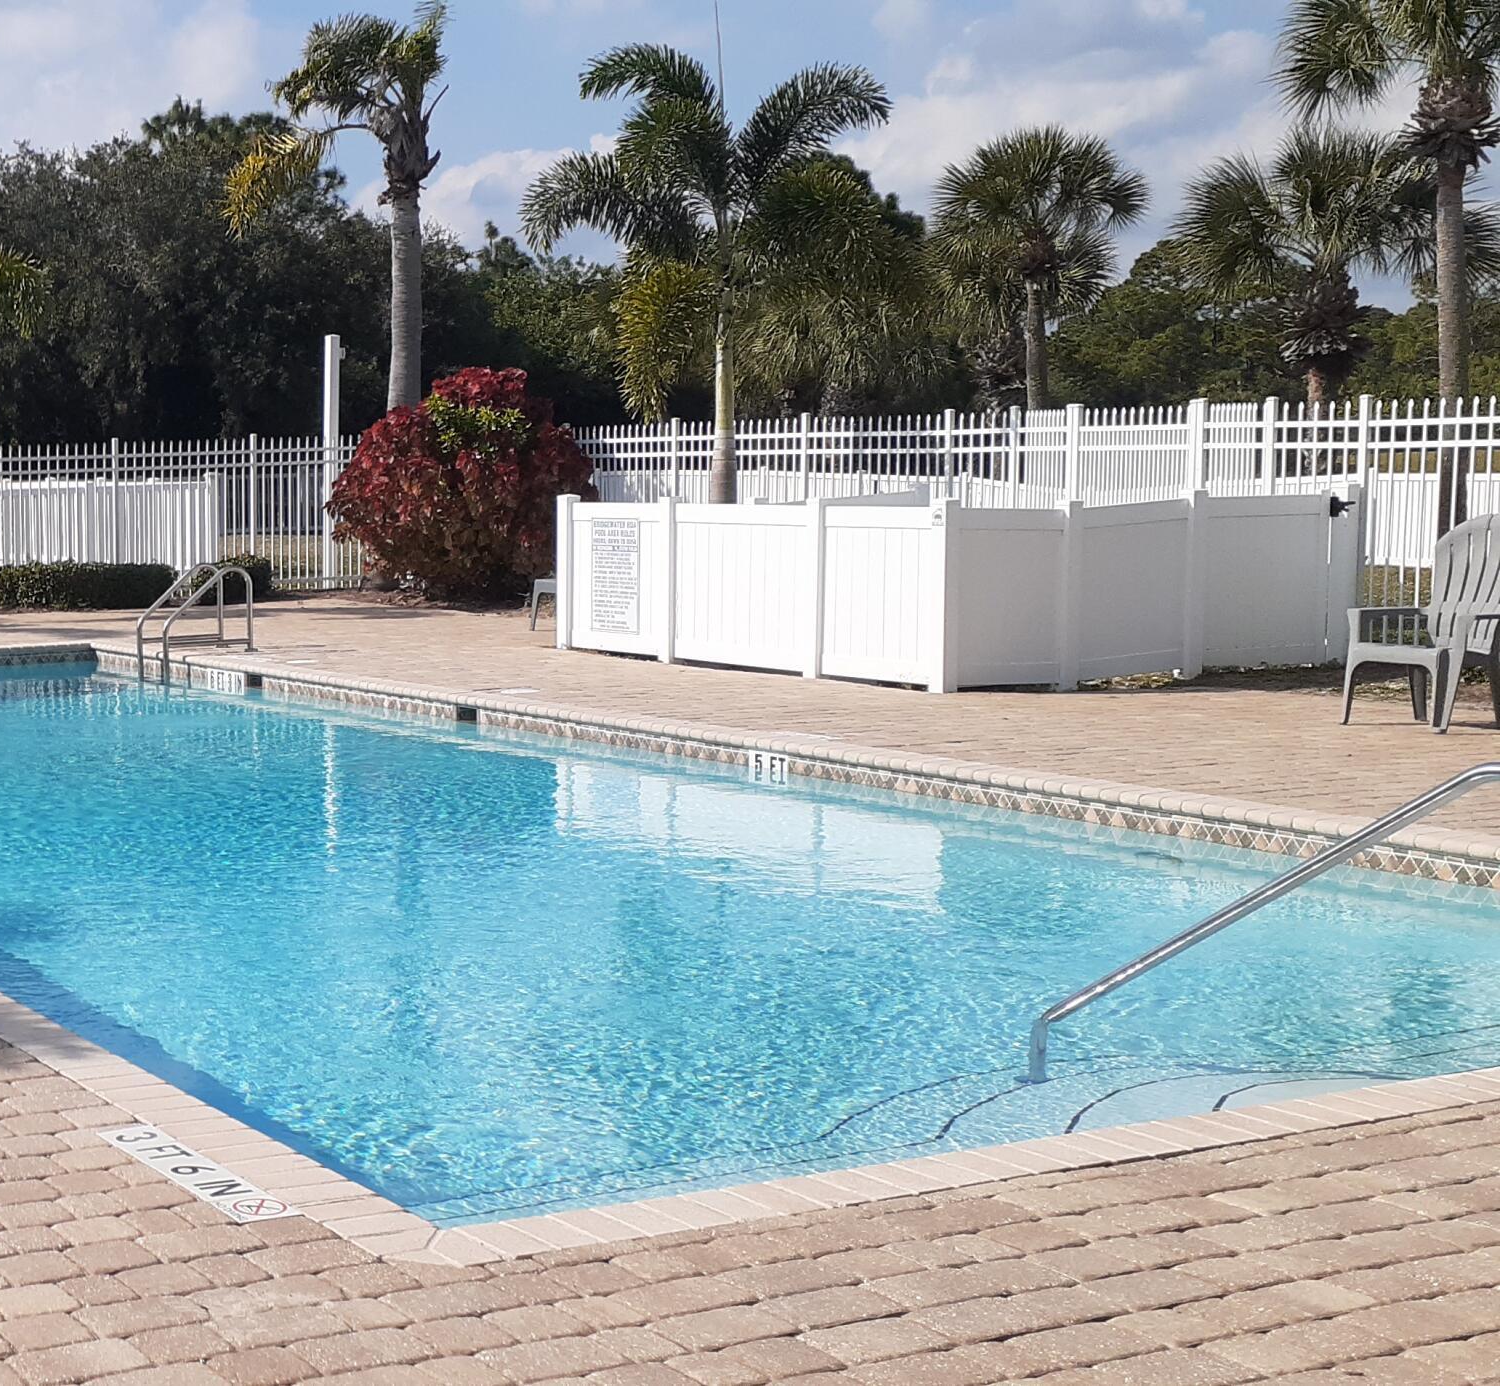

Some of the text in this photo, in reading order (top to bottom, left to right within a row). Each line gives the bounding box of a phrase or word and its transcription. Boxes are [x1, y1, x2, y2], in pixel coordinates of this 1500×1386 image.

[754, 753, 786, 776] 5 FT
[115, 1131, 254, 1197] 3 FT 6 IN
